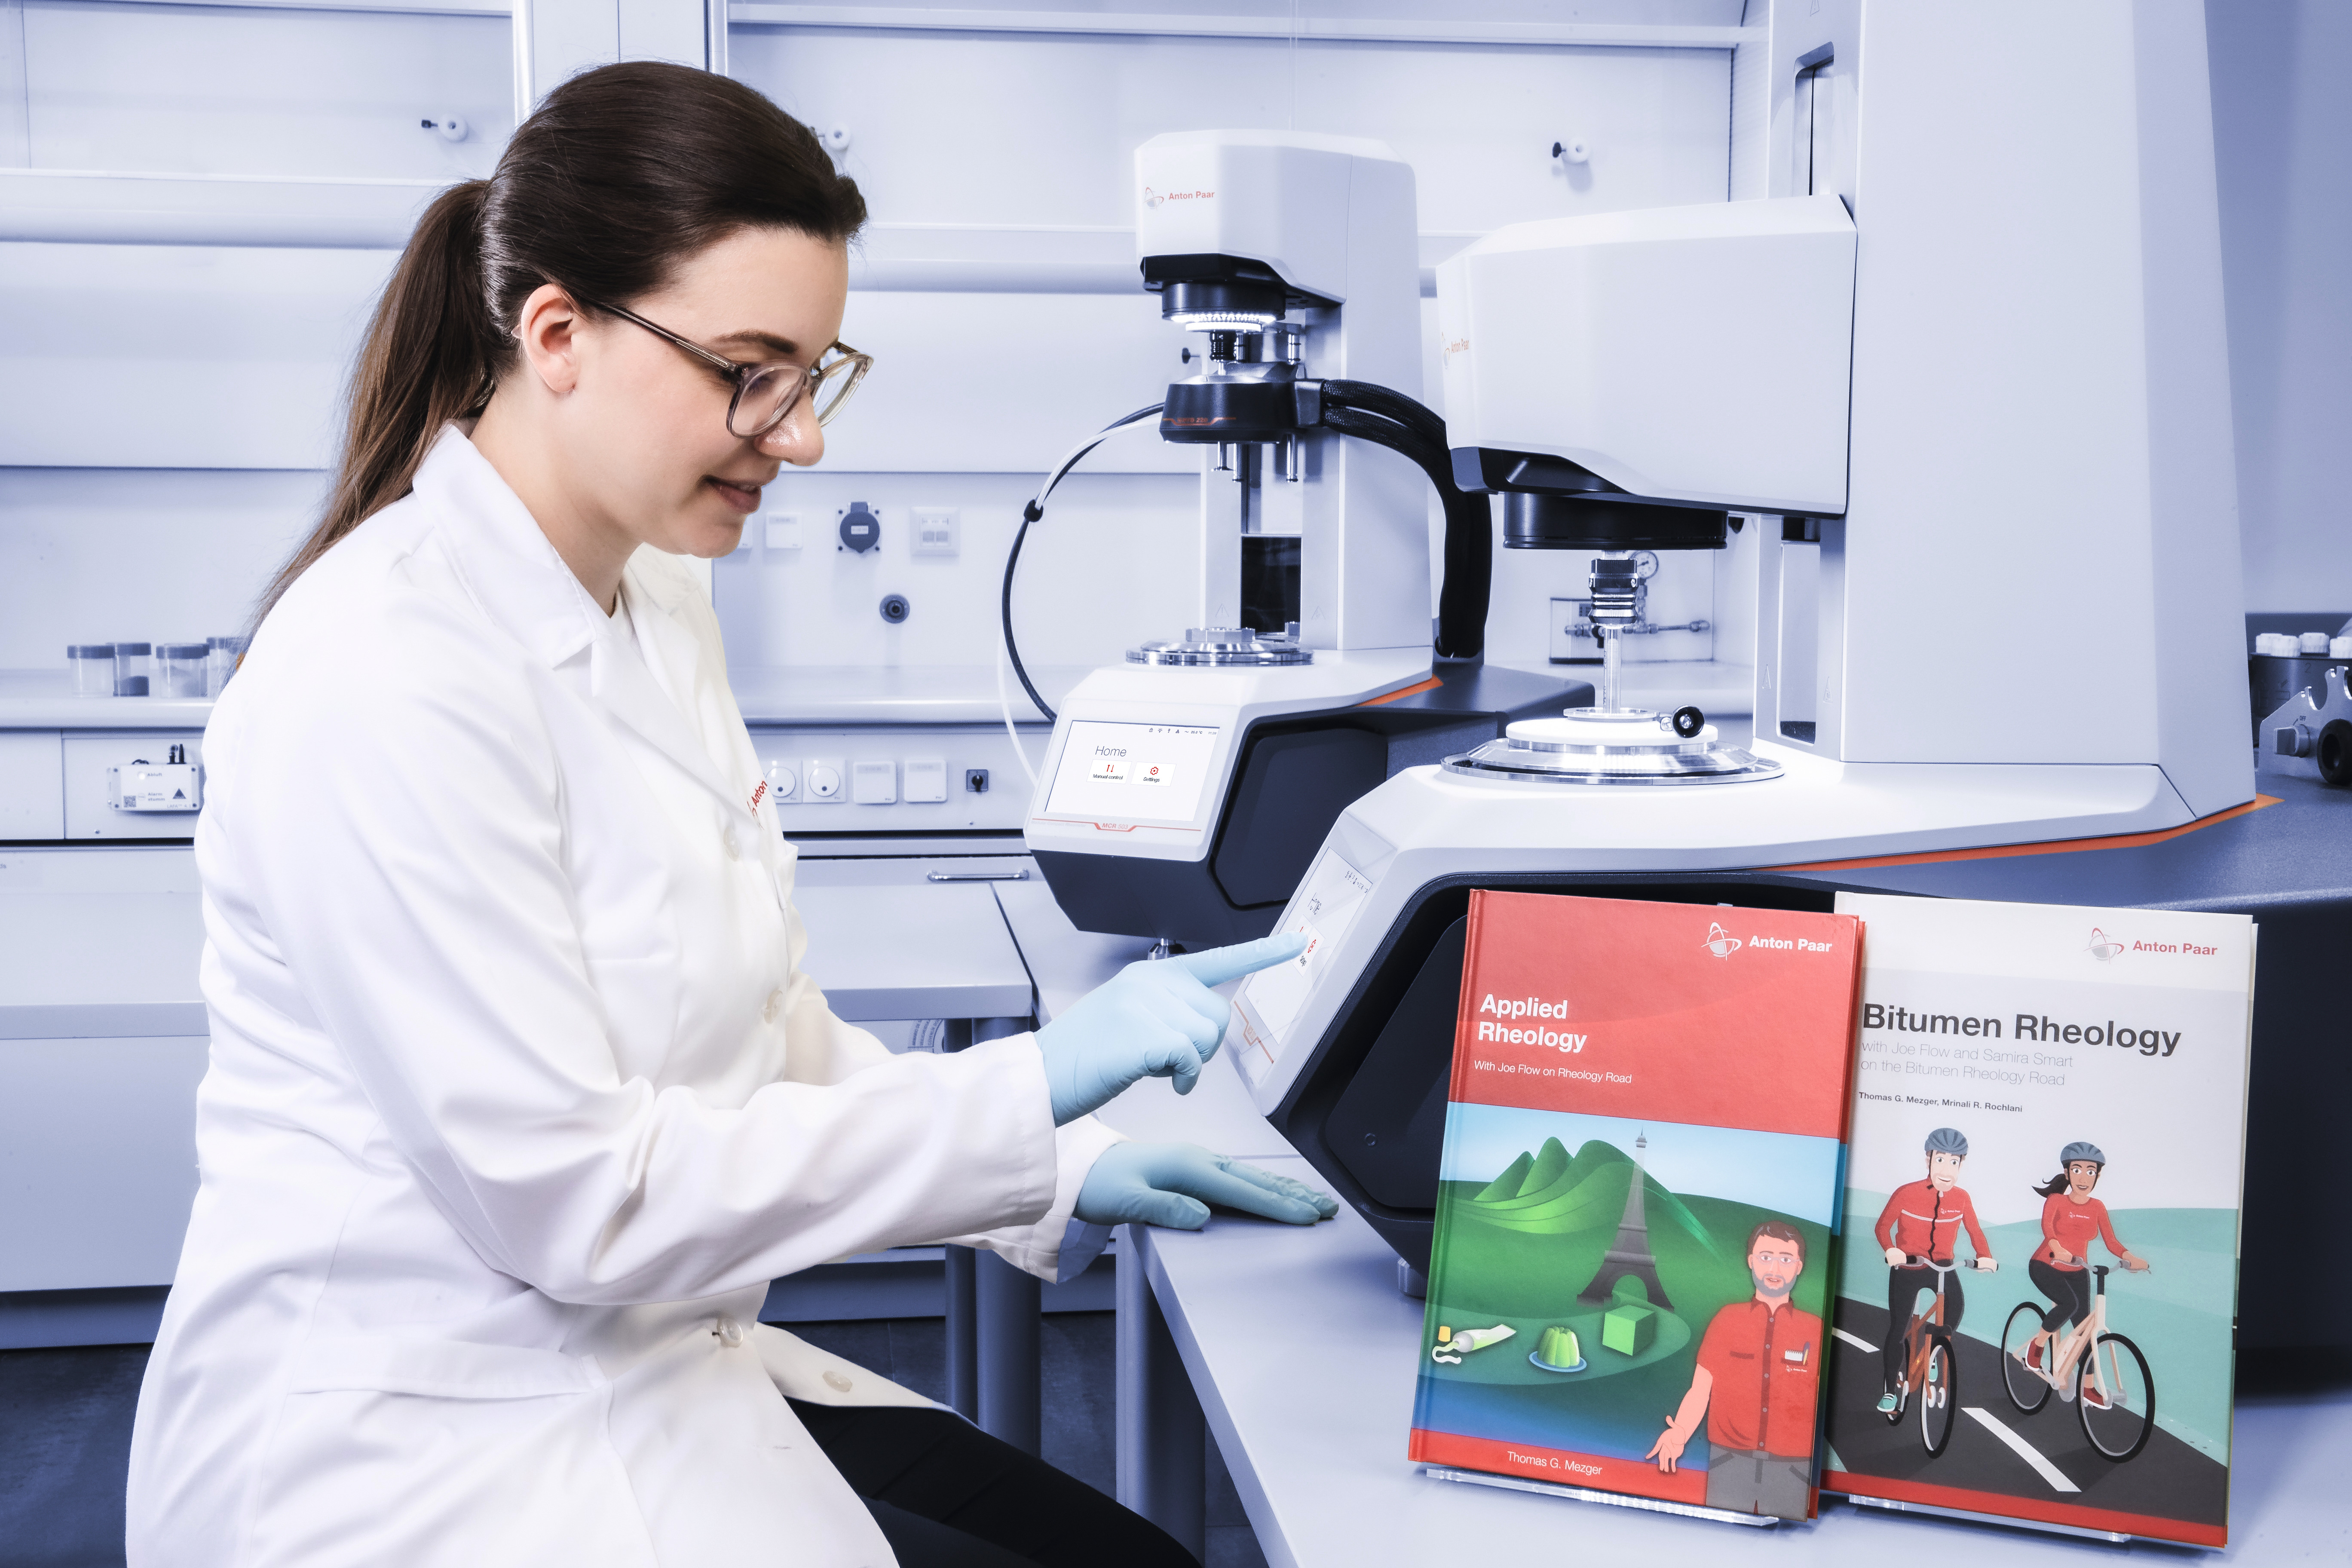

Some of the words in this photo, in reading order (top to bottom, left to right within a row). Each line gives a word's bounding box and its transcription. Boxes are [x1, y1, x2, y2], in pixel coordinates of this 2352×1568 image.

[1095, 745, 1127, 756] Home
[751, 781, 768, 807] Anton
[1749, 935, 1793, 949] Anton
[1798, 938, 1833, 952] Paar
[2133, 940, 2177, 953] Anton
[2183, 943, 2218, 955] Paar
[1479, 994, 1568, 1019] Applied
[1478, 1021, 1587, 1053] Rheology
[1863, 1003, 2002, 1038] Bitumen
[2015, 1014, 2182, 1057] Rheology
[1862, 1040, 1887, 1052] with
[1892, 1042, 1915, 1054] Joe
[1920, 1044, 1950, 1057] Flow
[1954, 1048, 1978, 1060] and
[1983, 1048, 2028, 1063] Samira
[2034, 1053, 2073, 1067] Smart
[1474, 1060, 1495, 1071] With
[1498, 1063, 1516, 1073] Joe
[1518, 1064, 1541, 1075] Flow
[1543, 1067, 1556, 1076] on
[1558, 1067, 1603, 1082] Rheology
[1606, 1072, 1632, 1084] Road
[1861, 1061, 1877, 1070] on
[1882, 1060, 1901, 1072] the
[1906, 1061, 1958, 1077] Bitumen
[1963, 1066, 2025, 1084] Rheology
[2030, 1071, 2065, 1085] Road
[1859, 1092, 1892, 1101] Thomas
[1906, 1096, 1939, 1106] Mezger,
[1942, 1099, 1971, 1108] Mrinali
[1985, 1103, 2023, 1112] Rochlani
[1507, 1451, 1547, 1467] Thomas
[1550, 1458, 1561, 1469] G.
[1565, 1459, 1603, 1476] Mezger
